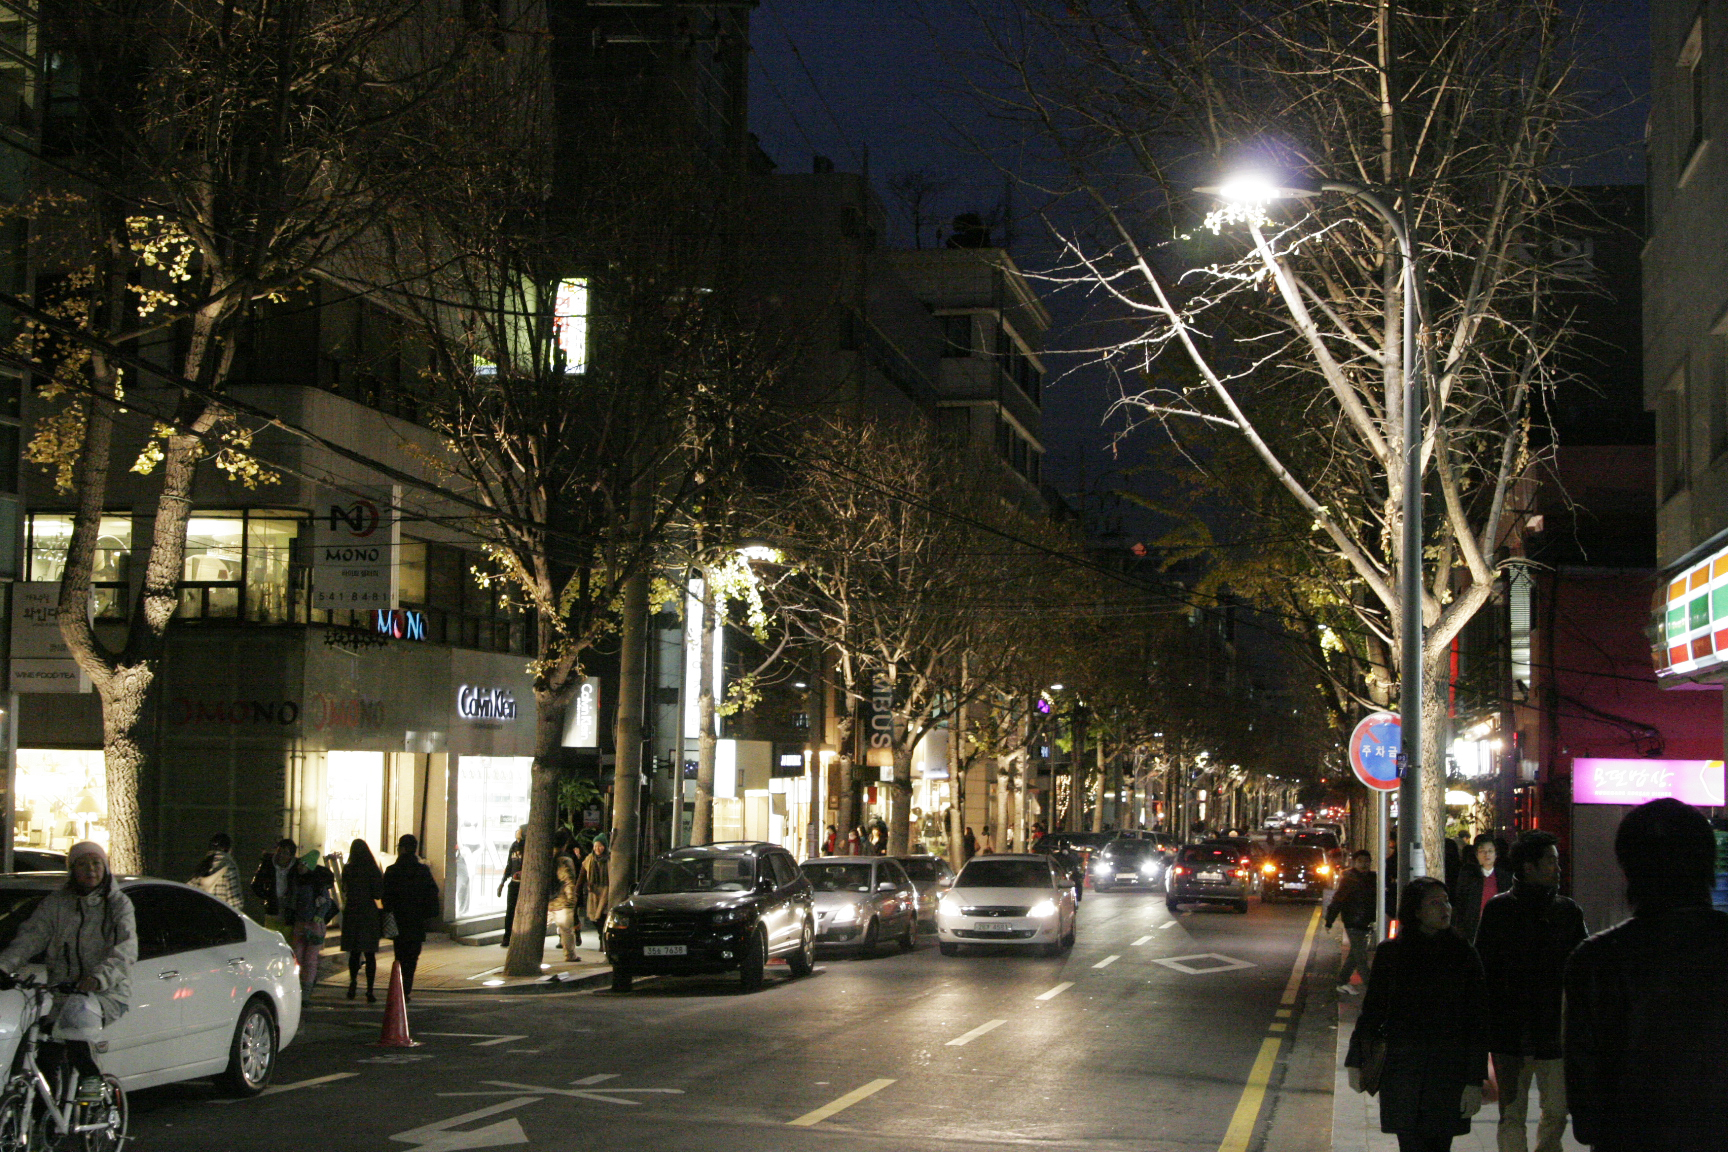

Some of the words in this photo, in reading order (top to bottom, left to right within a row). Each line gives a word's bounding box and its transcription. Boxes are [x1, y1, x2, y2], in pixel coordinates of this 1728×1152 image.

[326, 549, 379, 561] MONO
[459, 685, 492, 718] Calvin
[493, 688, 517, 719] Klein
[664, 946, 683, 954] 7638
